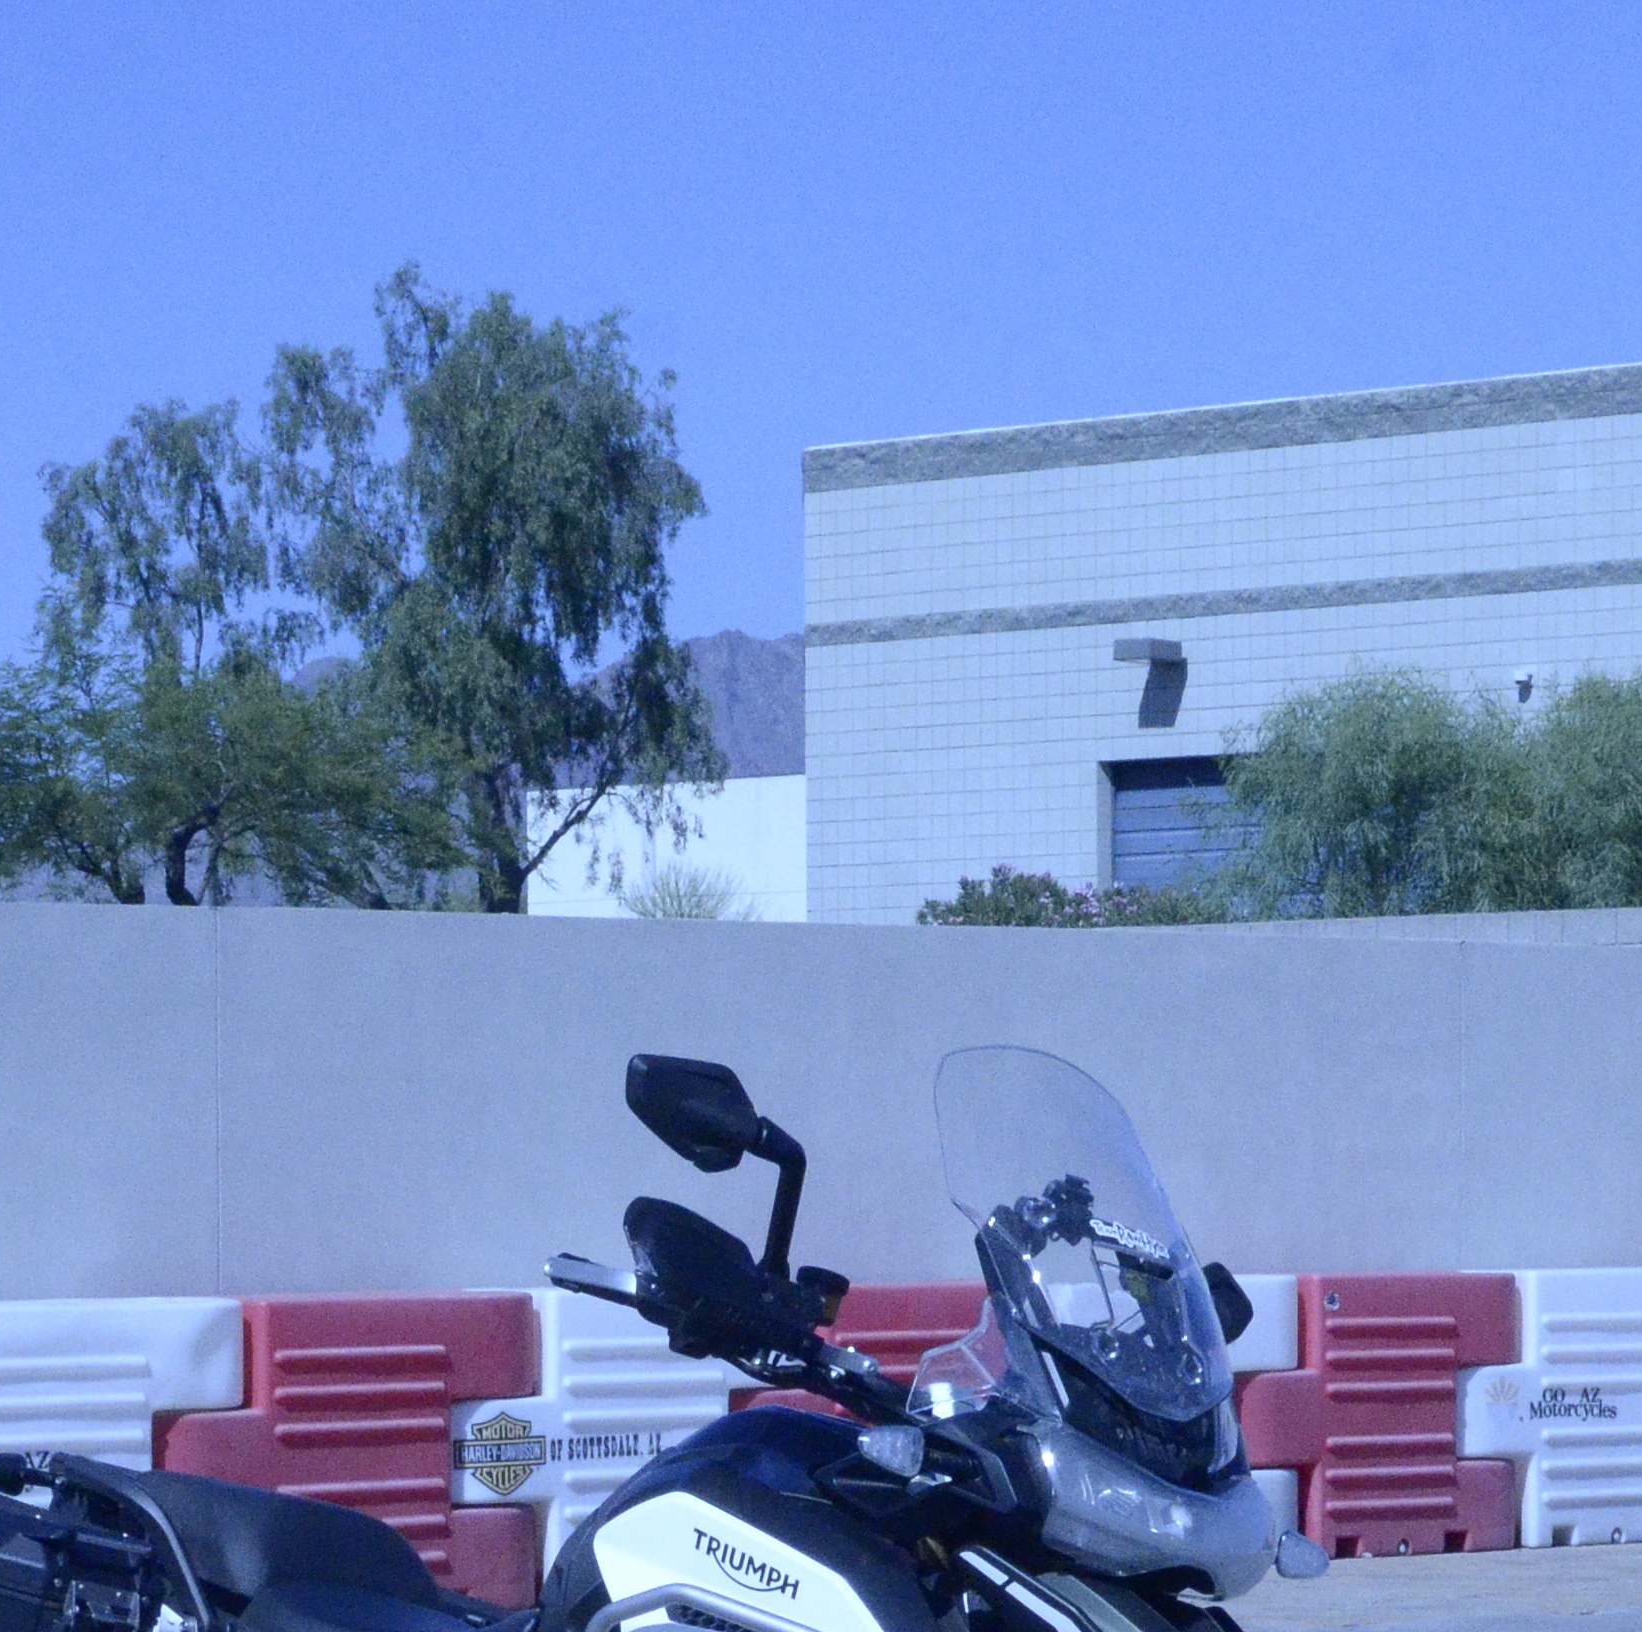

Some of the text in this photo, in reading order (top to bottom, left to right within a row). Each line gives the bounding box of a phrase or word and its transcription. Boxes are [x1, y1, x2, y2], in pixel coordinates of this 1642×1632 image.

[1542, 1387, 1600, 1403] GO AZ
[1529, 1400, 1617, 1421] Motorcycles
[481, 1424, 525, 1440] MOTOR
[550, 1438, 563, 1461] OF
[481, 1466, 525, 1489] CYCLES
[693, 1527, 800, 1600] TRIUMPH
